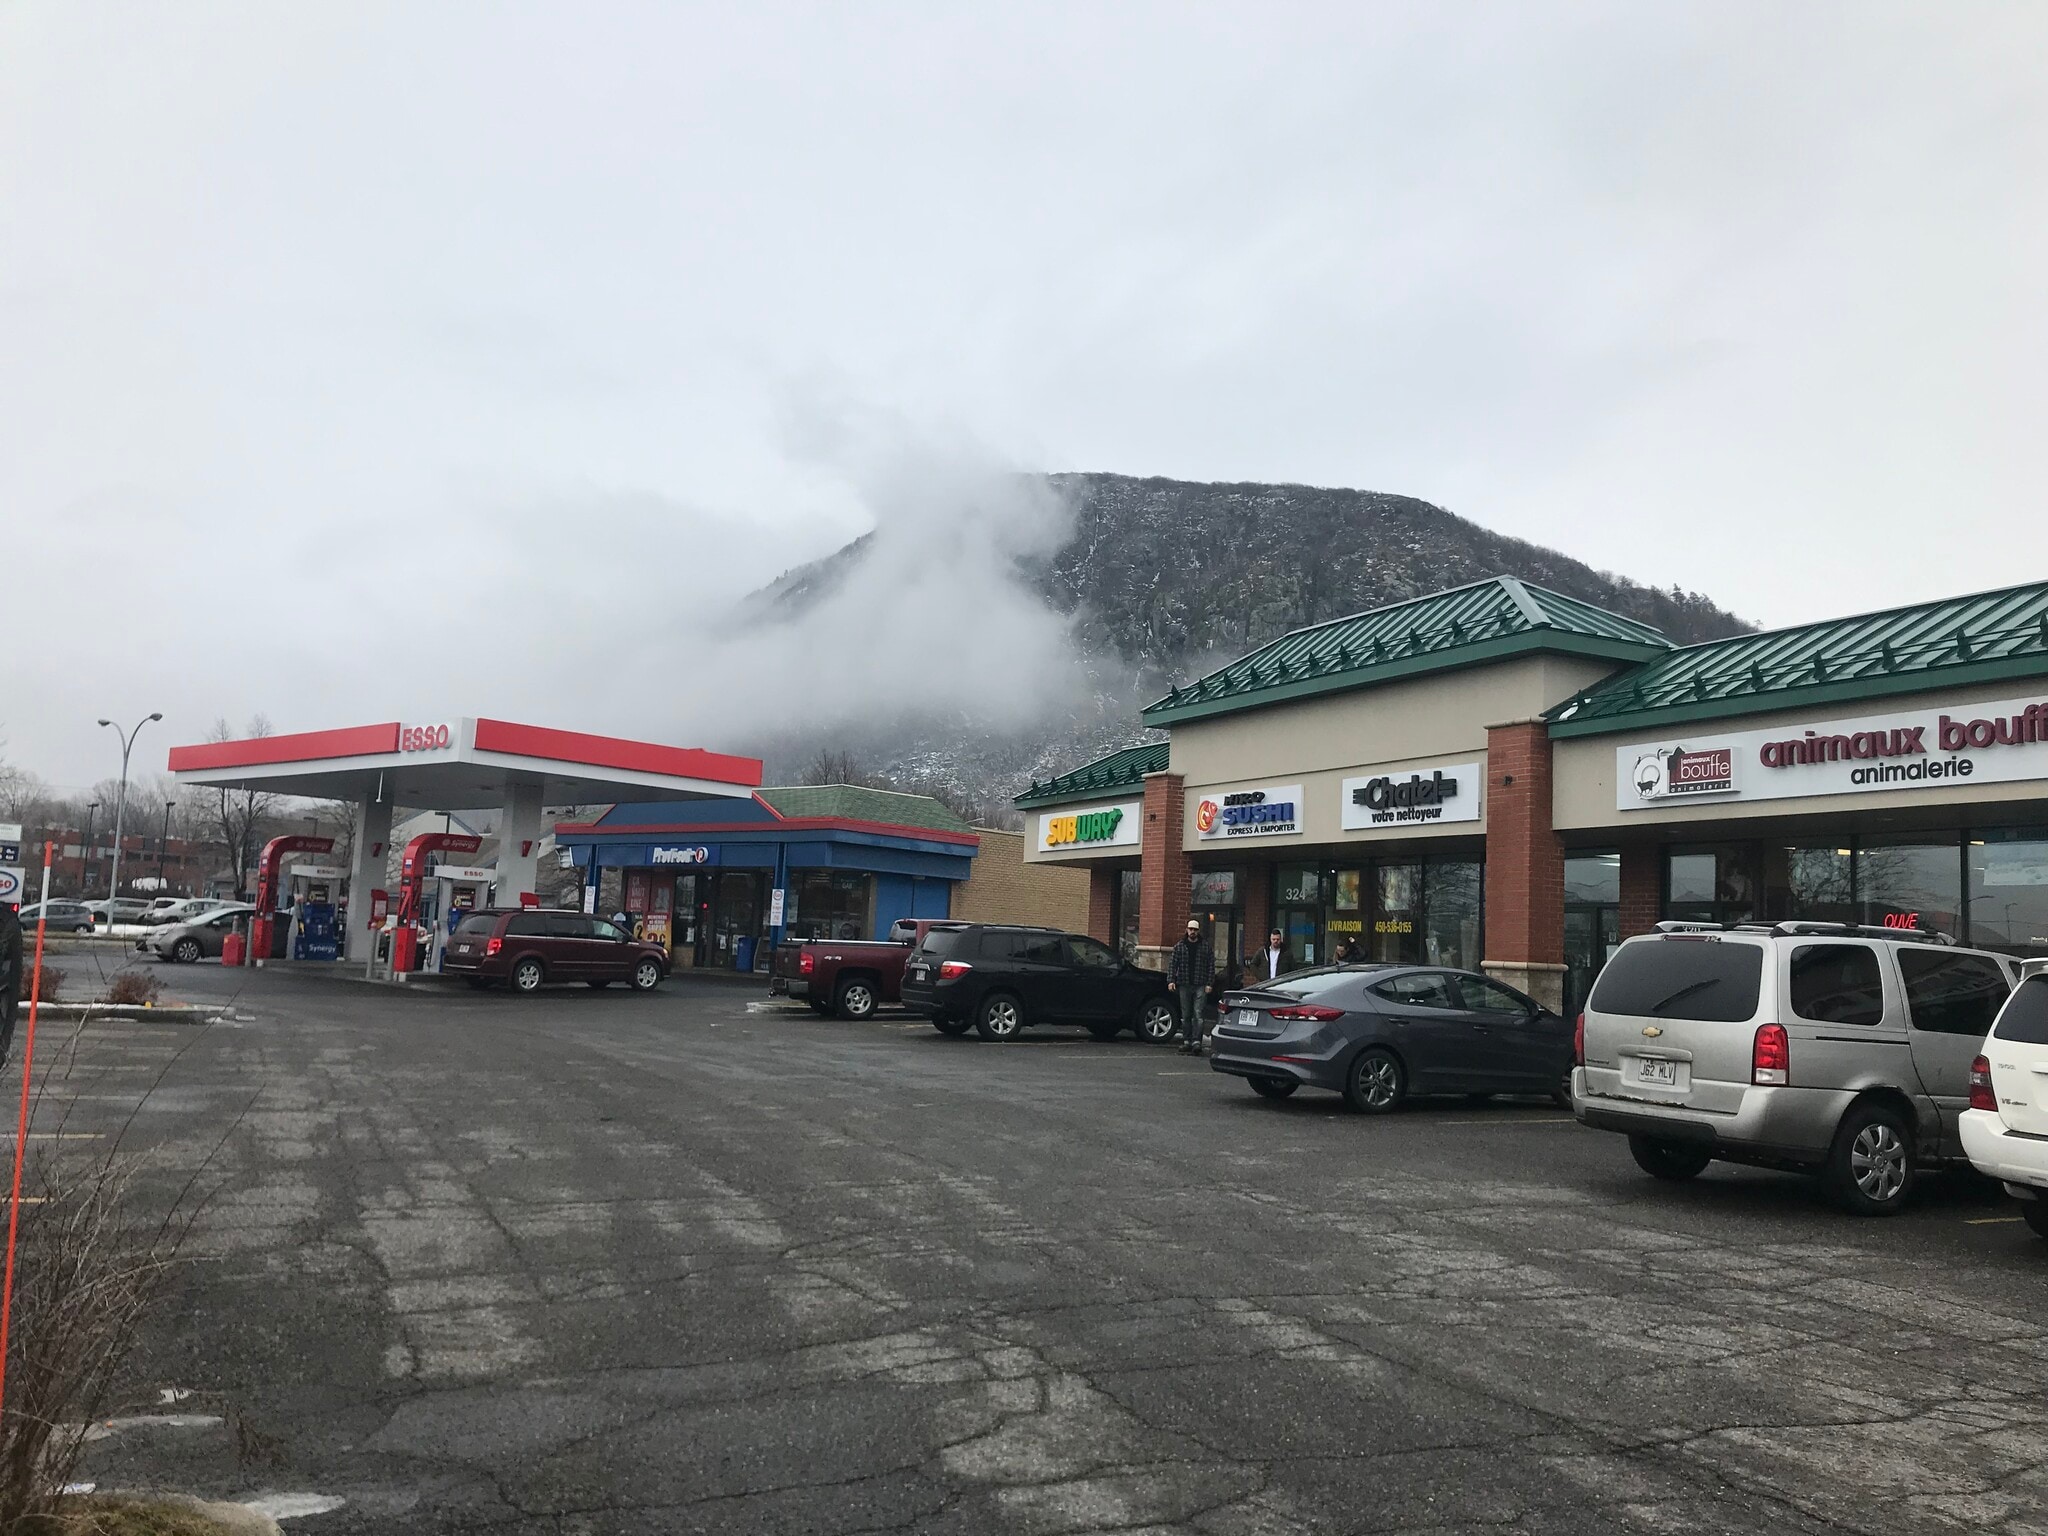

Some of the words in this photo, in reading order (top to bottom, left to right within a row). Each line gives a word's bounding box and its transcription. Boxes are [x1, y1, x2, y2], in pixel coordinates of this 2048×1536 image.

[402, 724, 451, 751] ESSO
[1759, 727, 1926, 769] animaux
[1681, 754, 1730, 779] bouffe
[1850, 756, 1974, 785] animalerie
[1364, 771, 1443, 810] Chatel
[1223, 802, 1294, 825] SUSHI
[1371, 811, 1394, 823] votre
[1396, 807, 1443, 822] nettoyeur
[1046, 808, 1123, 847] SUBWAY
[1227, 827, 1253, 836] EXPRESS
[1261, 824, 1295, 833] EMPORTER
[1285, 888, 1306, 900] 324
[1327, 920, 1362, 932] LIVRAISON
[309, 945, 337, 954] Synergy
[1640, 1064, 1656, 1077] J62
[1659, 1066, 1674, 1079] MLV
